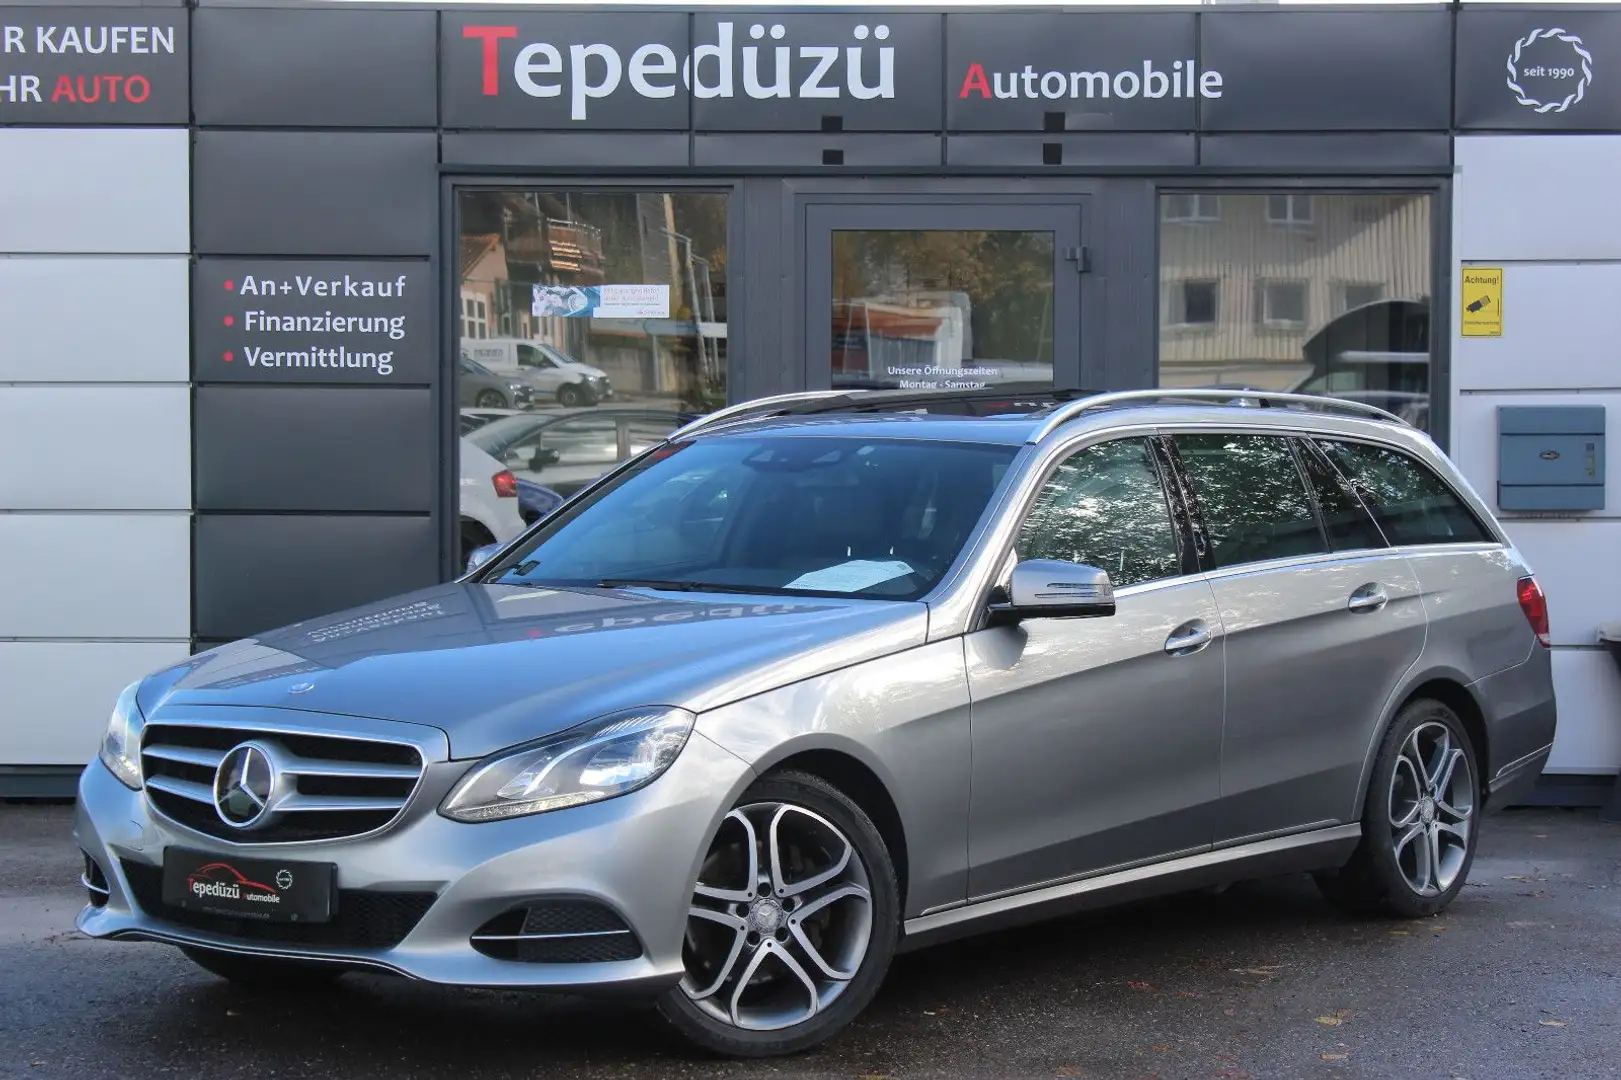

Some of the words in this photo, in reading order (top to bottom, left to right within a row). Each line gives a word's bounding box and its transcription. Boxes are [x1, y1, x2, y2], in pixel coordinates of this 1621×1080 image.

[36, 26, 175, 54] KAUFEN
[462, 22, 895, 120] Tepedüzü
[957, 60, 1223, 99] Automobile
[1523, 65, 1545, 77] seit
[1547, 68, 1574, 79] 1990
[51, 74, 151, 104] AUTO
[240, 275, 407, 297] An+Verkauf
[1464, 275, 1499, 285] Achtung!
[244, 310, 406, 340] Finanzierung
[243, 346, 394, 375] Vermittlung
[887, 366, 921, 375] Unsere
[923, 365, 998, 377] Öffnungszeiten
[899, 380, 937, 389] Montag
[944, 380, 985, 389] Samstag
[187, 877, 240, 899] Tepedüzü
